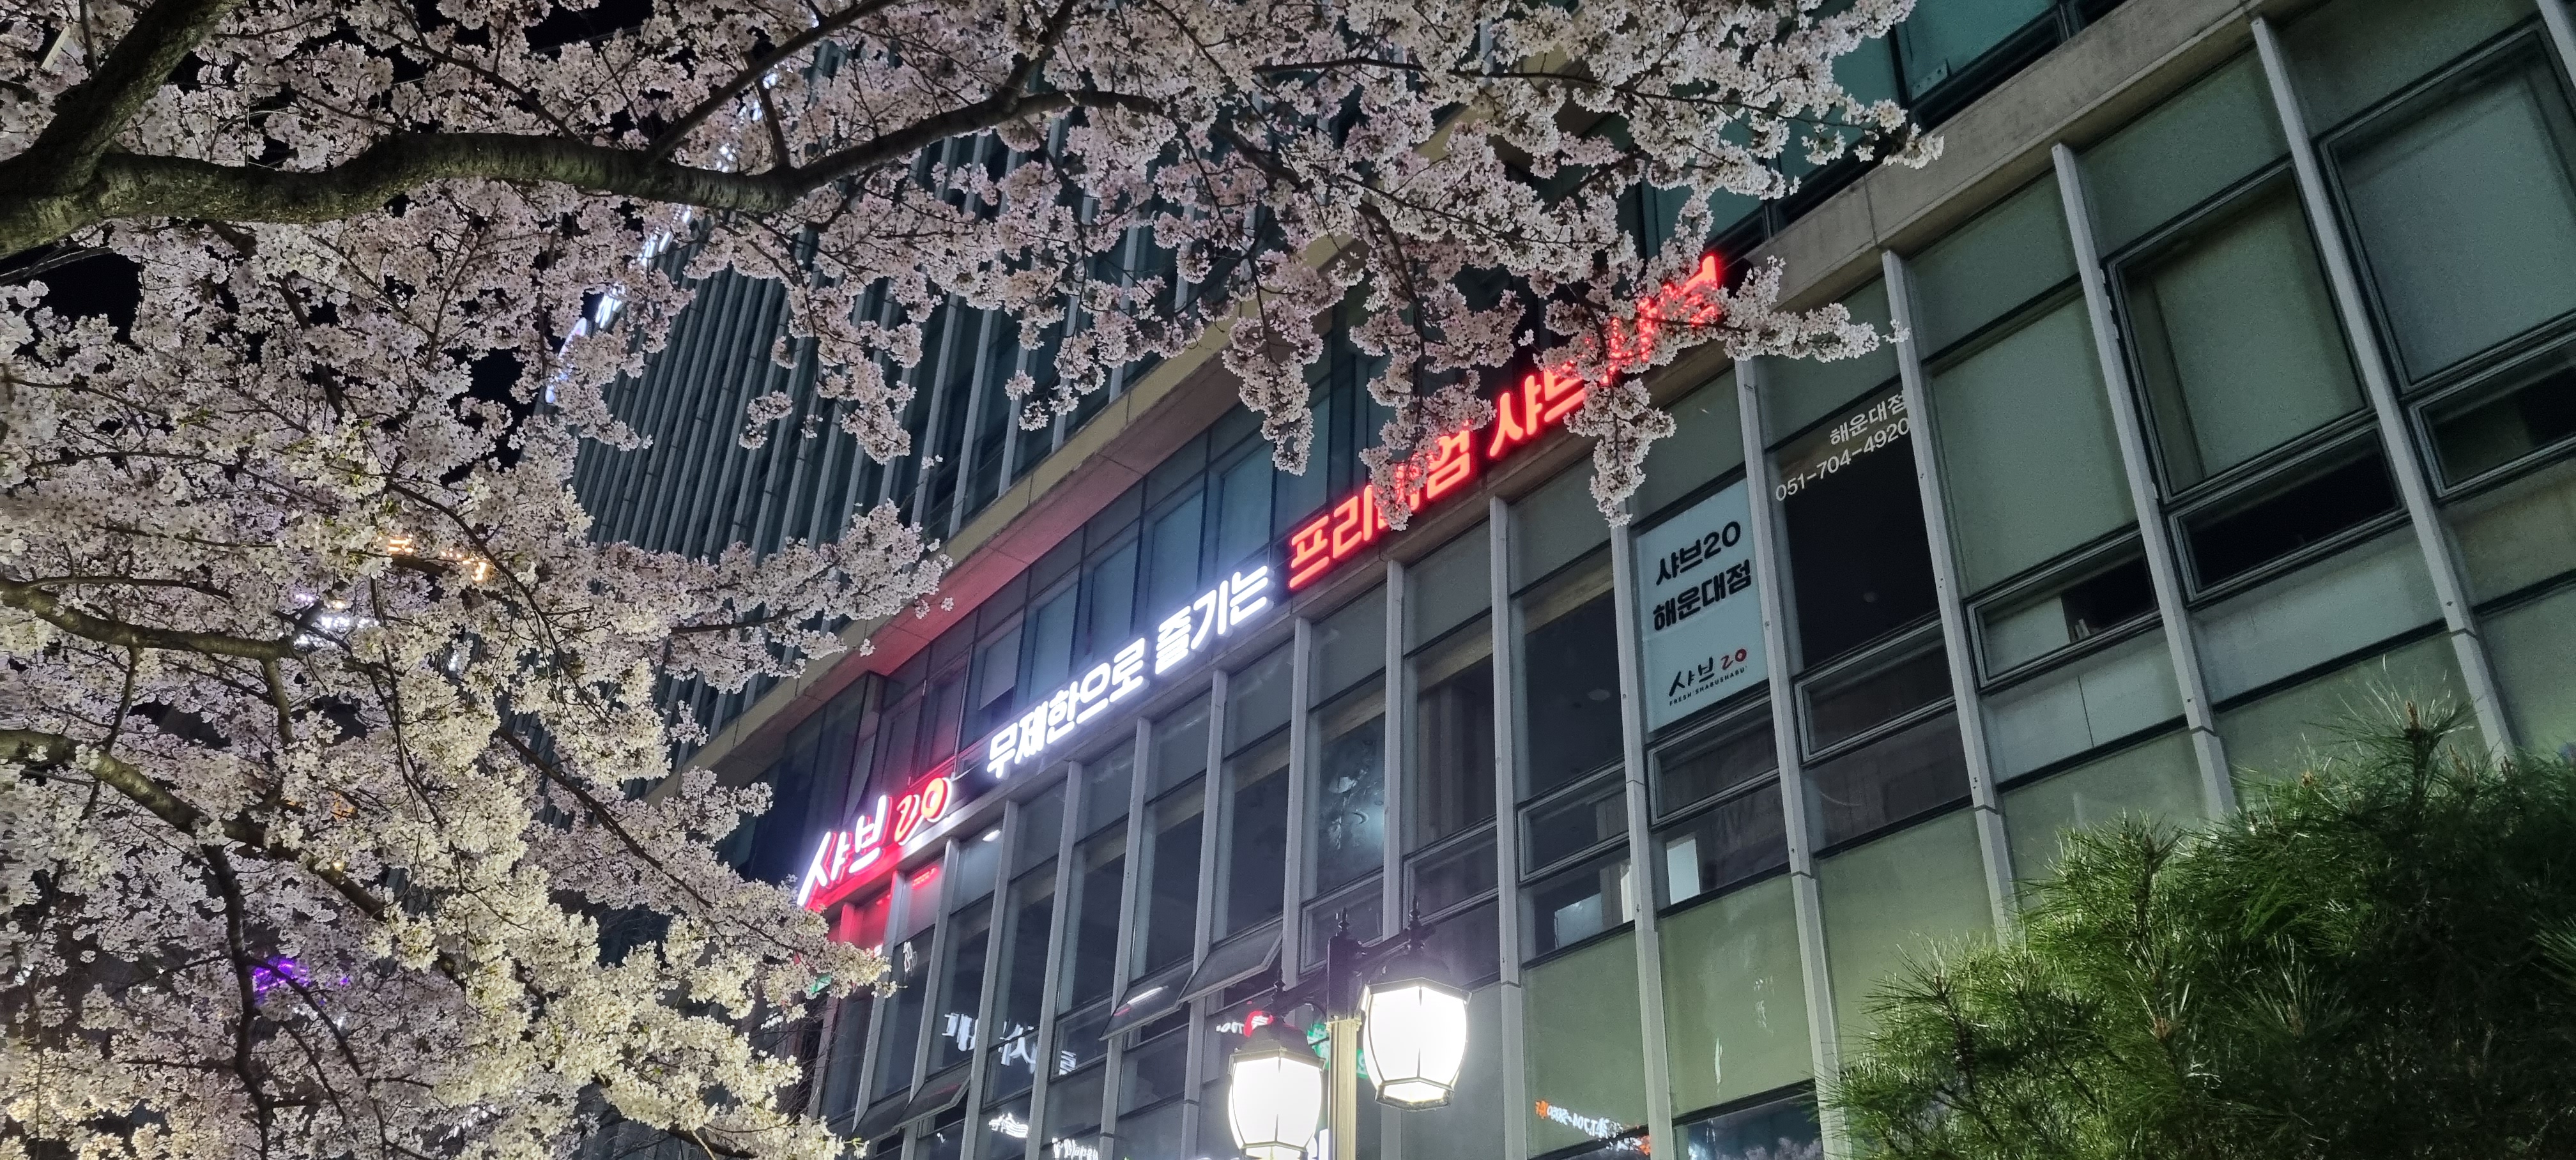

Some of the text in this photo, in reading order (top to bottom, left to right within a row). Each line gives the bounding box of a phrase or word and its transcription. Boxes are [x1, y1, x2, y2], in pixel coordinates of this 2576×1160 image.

[1829, 393, 1907, 445] 해운대점
[1775, 417, 1910, 501] 051-704-4920
[1656, 521, 1741, 586] 샤브20
[1653, 559, 1751, 631] 해운대점
[987, 637, 1146, 779] 무제한으로
[1155, 565, 1268, 675] 즐기는
[1669, 648, 1747, 697] 샤브 20
[1669, 691, 1692, 706] FRESH
[797, 777, 953, 900] 샤브 20
